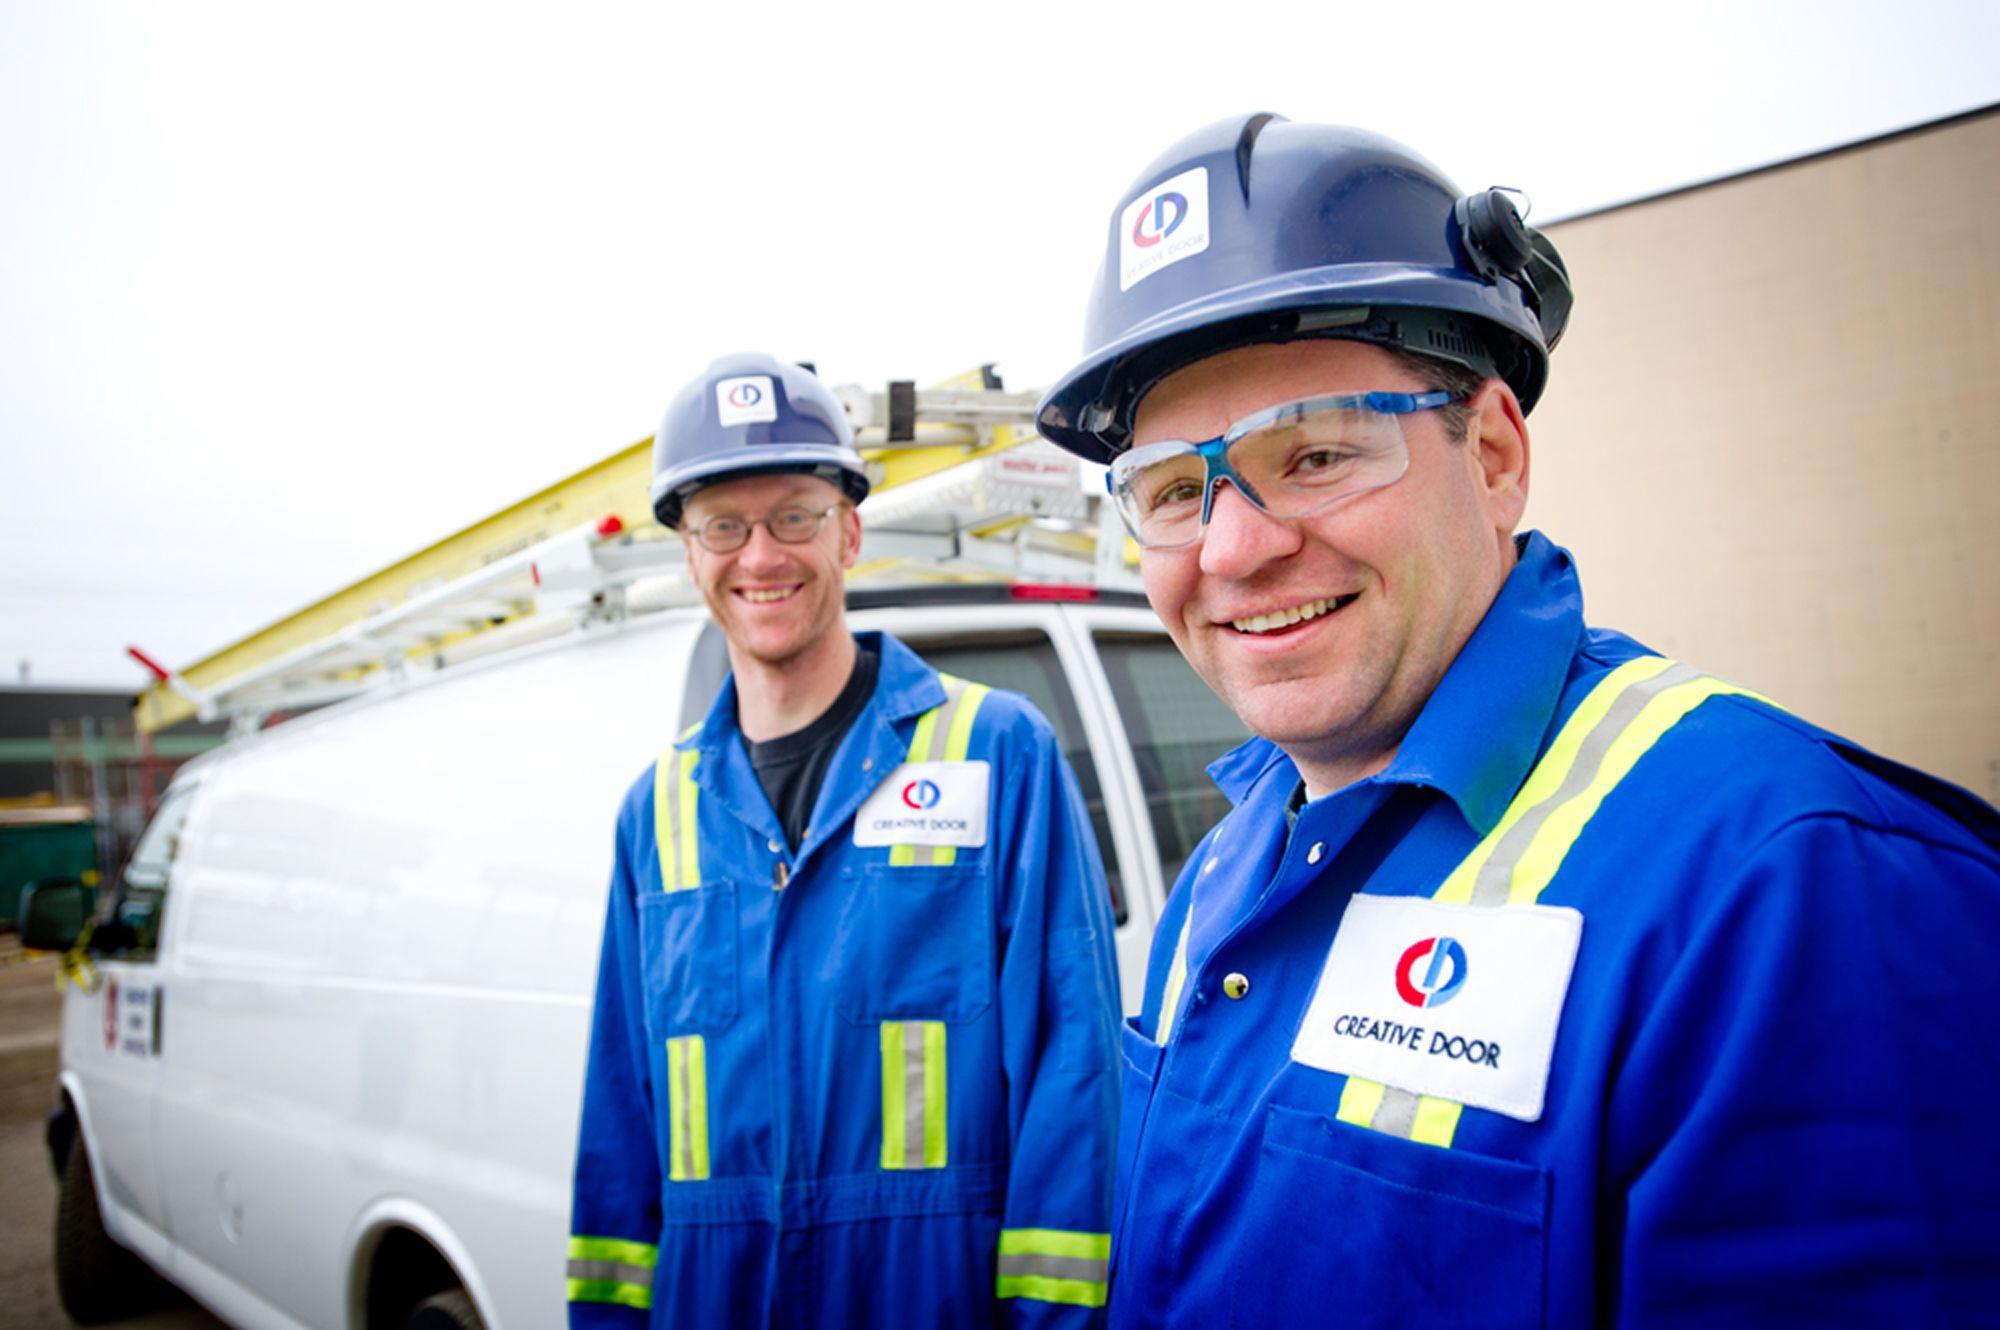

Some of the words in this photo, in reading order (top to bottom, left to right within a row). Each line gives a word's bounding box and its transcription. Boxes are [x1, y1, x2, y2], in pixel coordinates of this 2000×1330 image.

[873, 818, 926, 831] CREATIVE
[930, 818, 967, 831] DOOR
[1333, 1014, 1425, 1051] CREATIVE
[1428, 1030, 1501, 1069] DOOR
